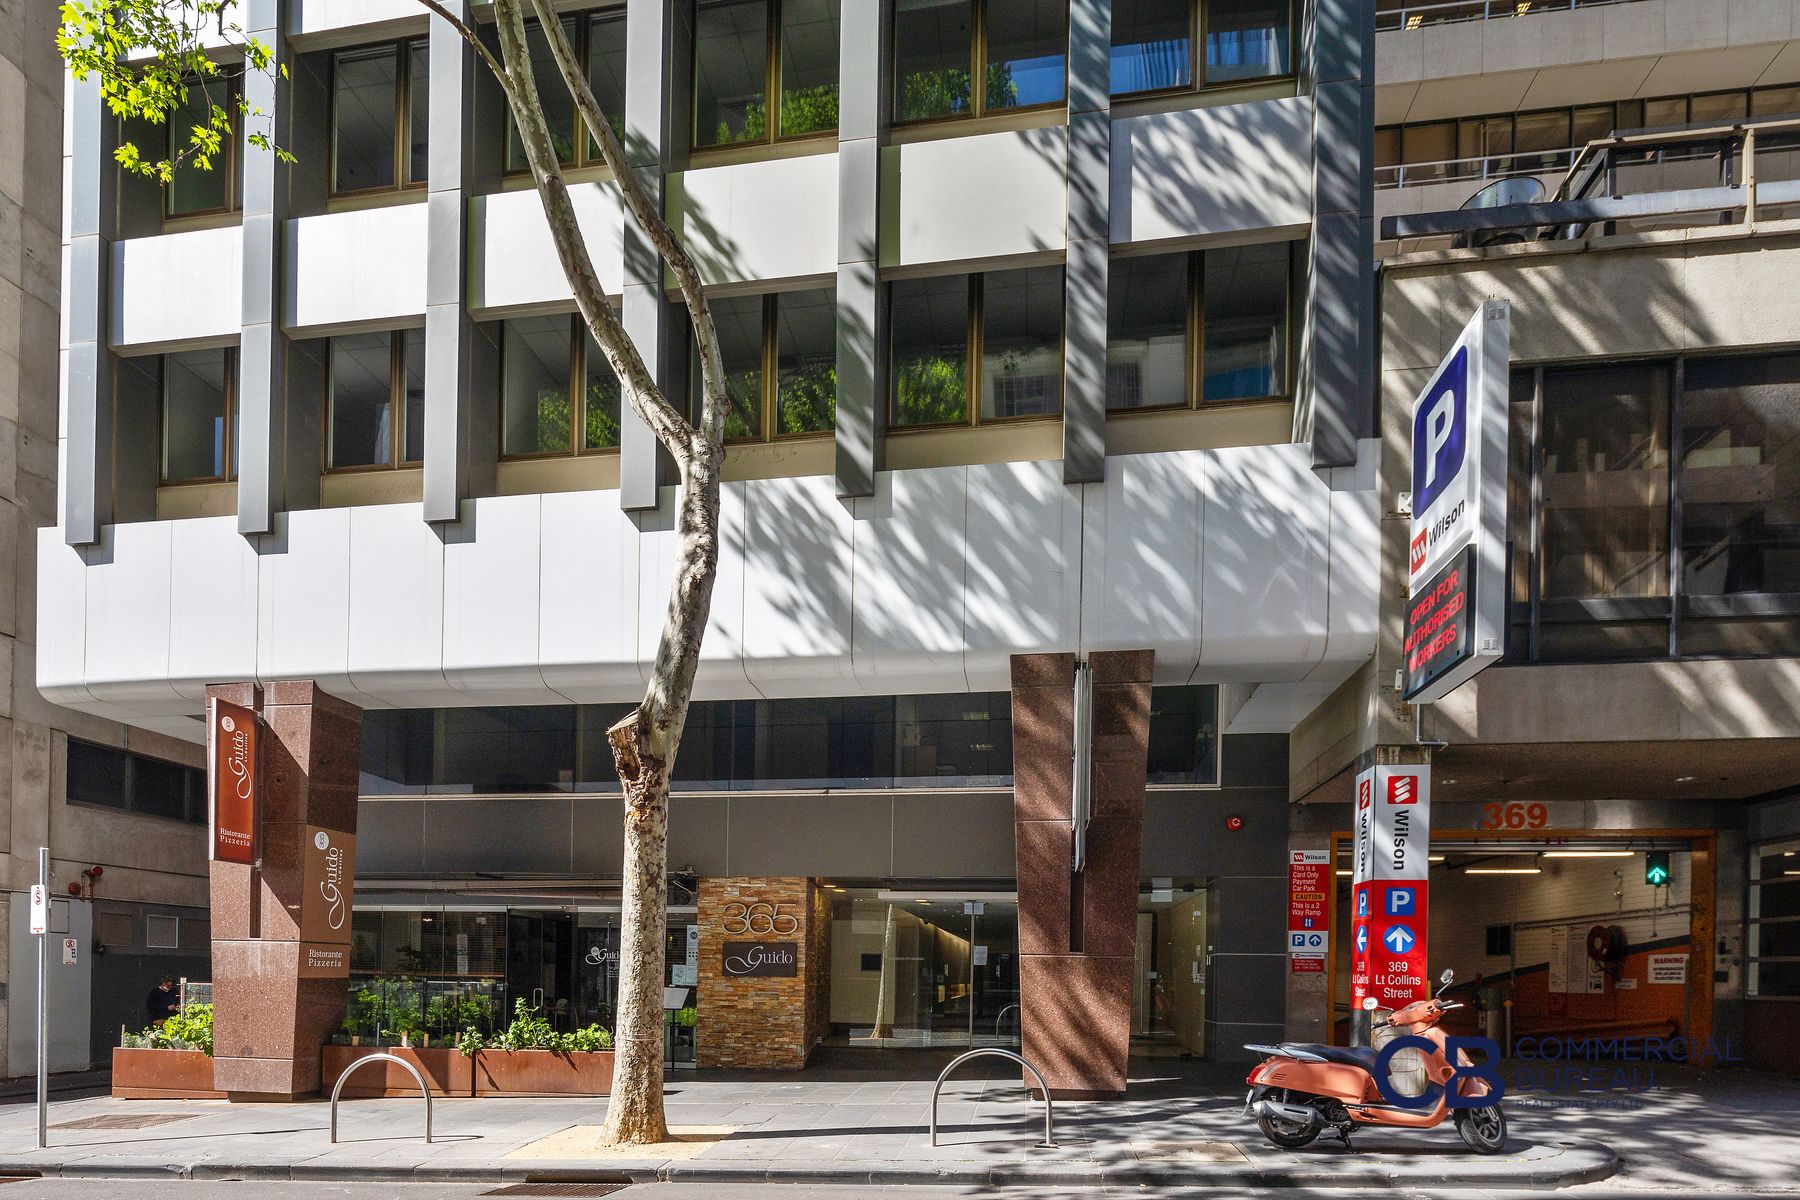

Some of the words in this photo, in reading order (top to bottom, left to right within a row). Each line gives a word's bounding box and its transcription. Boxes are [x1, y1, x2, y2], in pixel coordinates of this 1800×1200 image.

[1425, 389, 1455, 489] P
[1428, 499, 1465, 548] Wilson
[1410, 591, 1436, 625] OPEN
[1436, 569, 1459, 603] FOR
[1403, 591, 1465, 656] AUTHORISED
[1408, 623, 1457, 673] WORKERS
[228, 730, 252, 799] Guido
[1482, 802, 1548, 830] 369
[220, 827, 251, 840] Ristorante
[220, 835, 251, 847] Pizzeria
[1393, 809, 1410, 870] Wilson
[320, 847, 346, 930] Guido
[1292, 909, 1304, 917] Way
[1358, 892, 1367, 914] P
[1391, 890, 1410, 913] P
[721, 902, 798, 935] 365
[1294, 935, 1303, 945] P
[308, 958, 342, 967] Pizzeria
[309, 949, 343, 959] Ristorante
[585, 948, 621, 965] Guid
[725, 945, 793, 974] Guido
[1388, 961, 1408, 972] 369
[1376, 974, 1387, 985] Lt
[1387, 974, 1421, 985] Collins
[1383, 988, 1413, 999] Street
